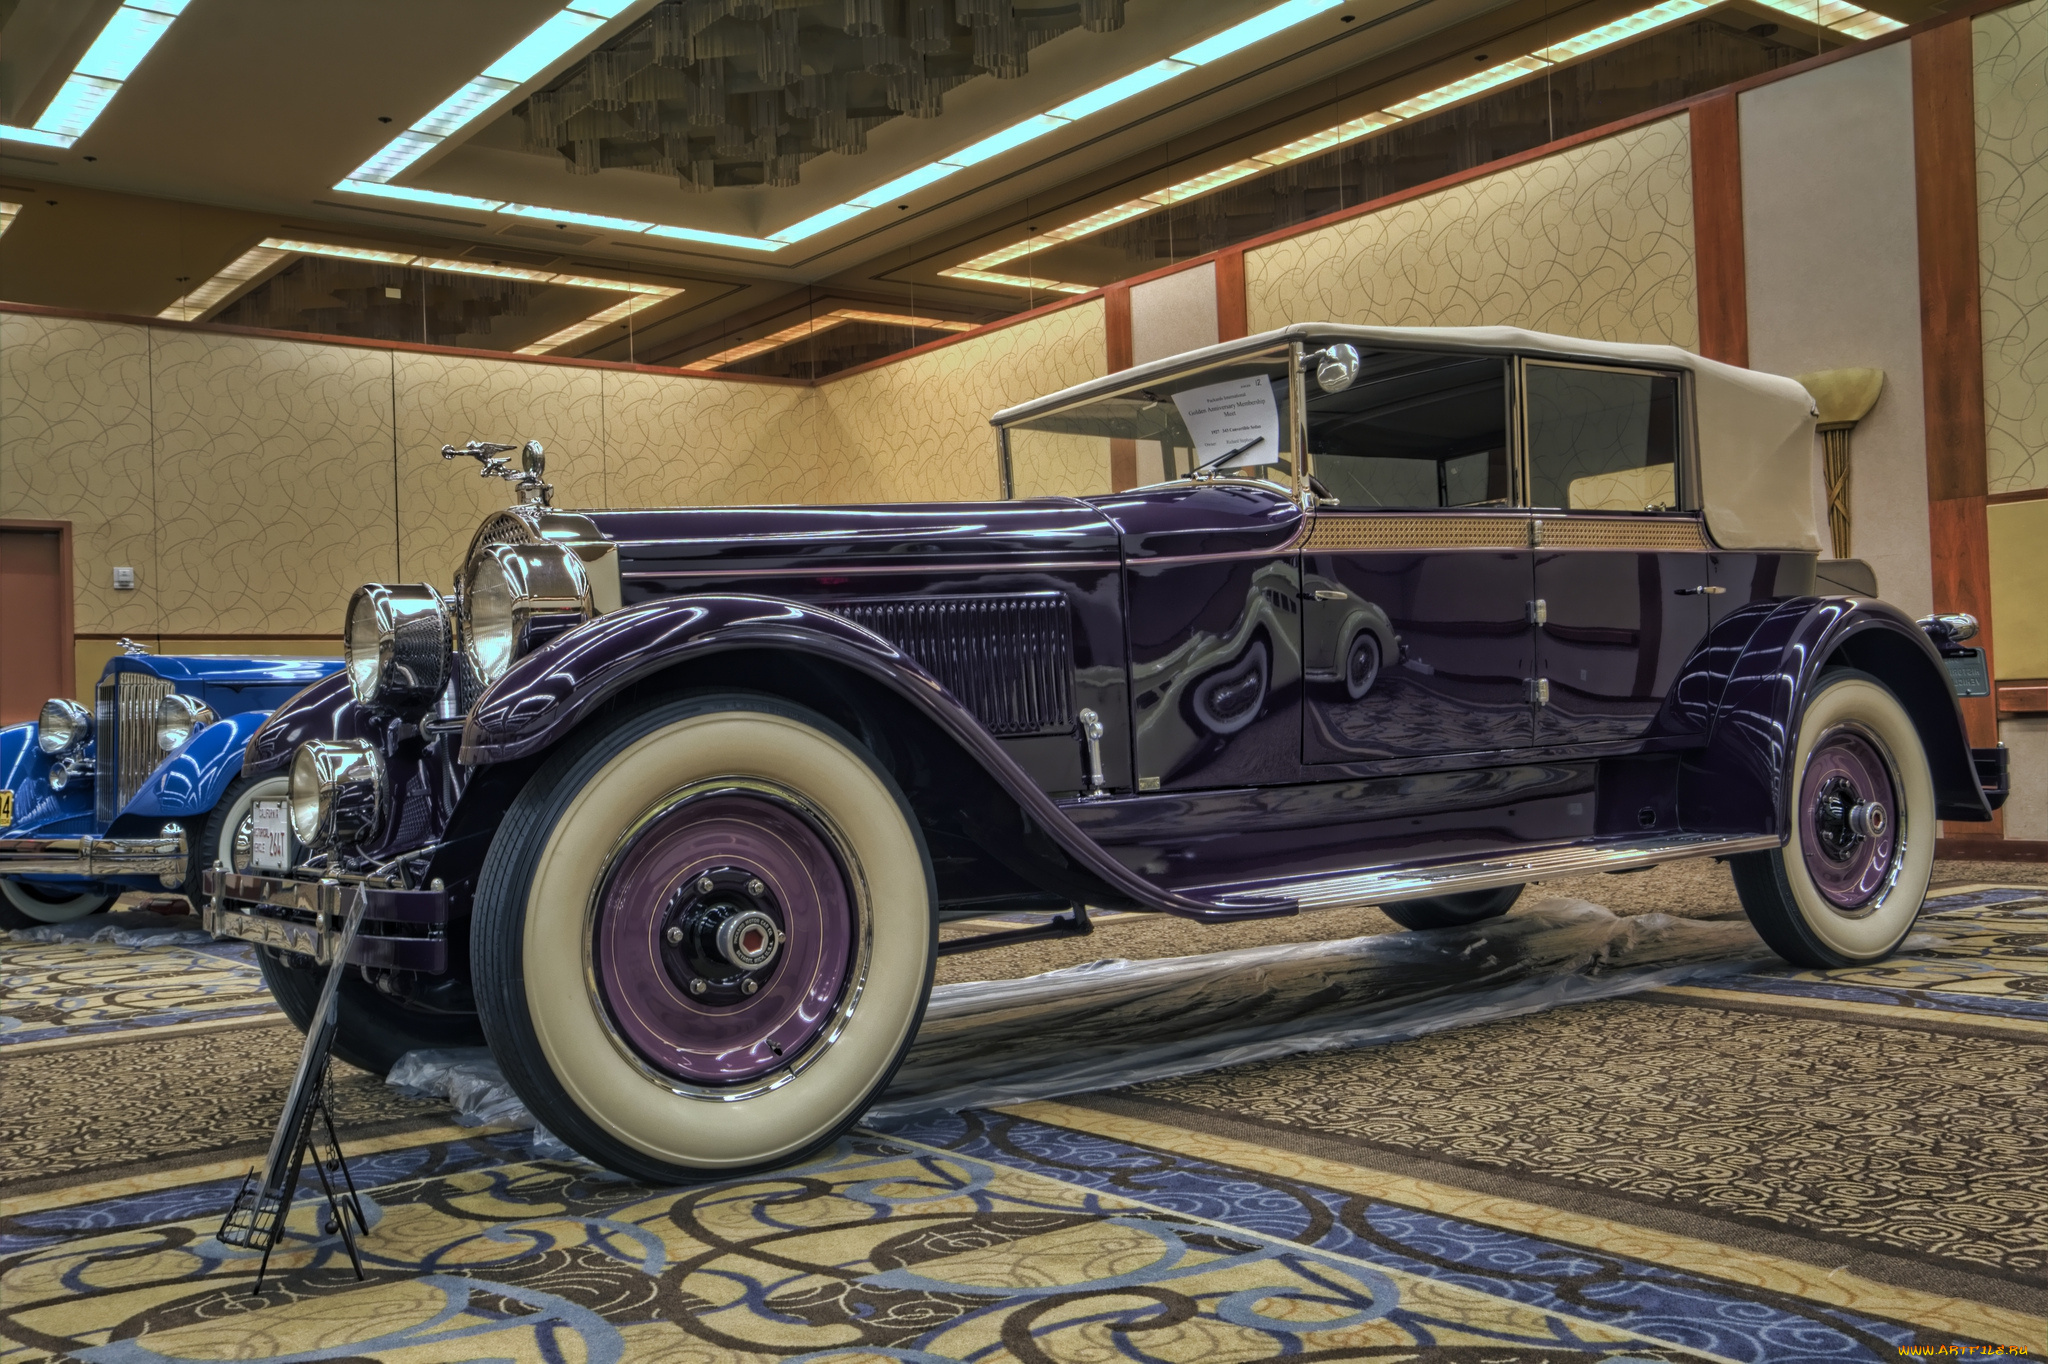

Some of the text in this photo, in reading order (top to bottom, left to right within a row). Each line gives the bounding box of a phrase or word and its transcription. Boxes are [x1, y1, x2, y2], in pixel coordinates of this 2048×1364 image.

[1224, 392, 1246, 401] International
[1188, 399, 1266, 416] Golden Anniversary Membership
[734, 923, 745, 944] PACKARD
[760, 920, 770, 928] CAR
